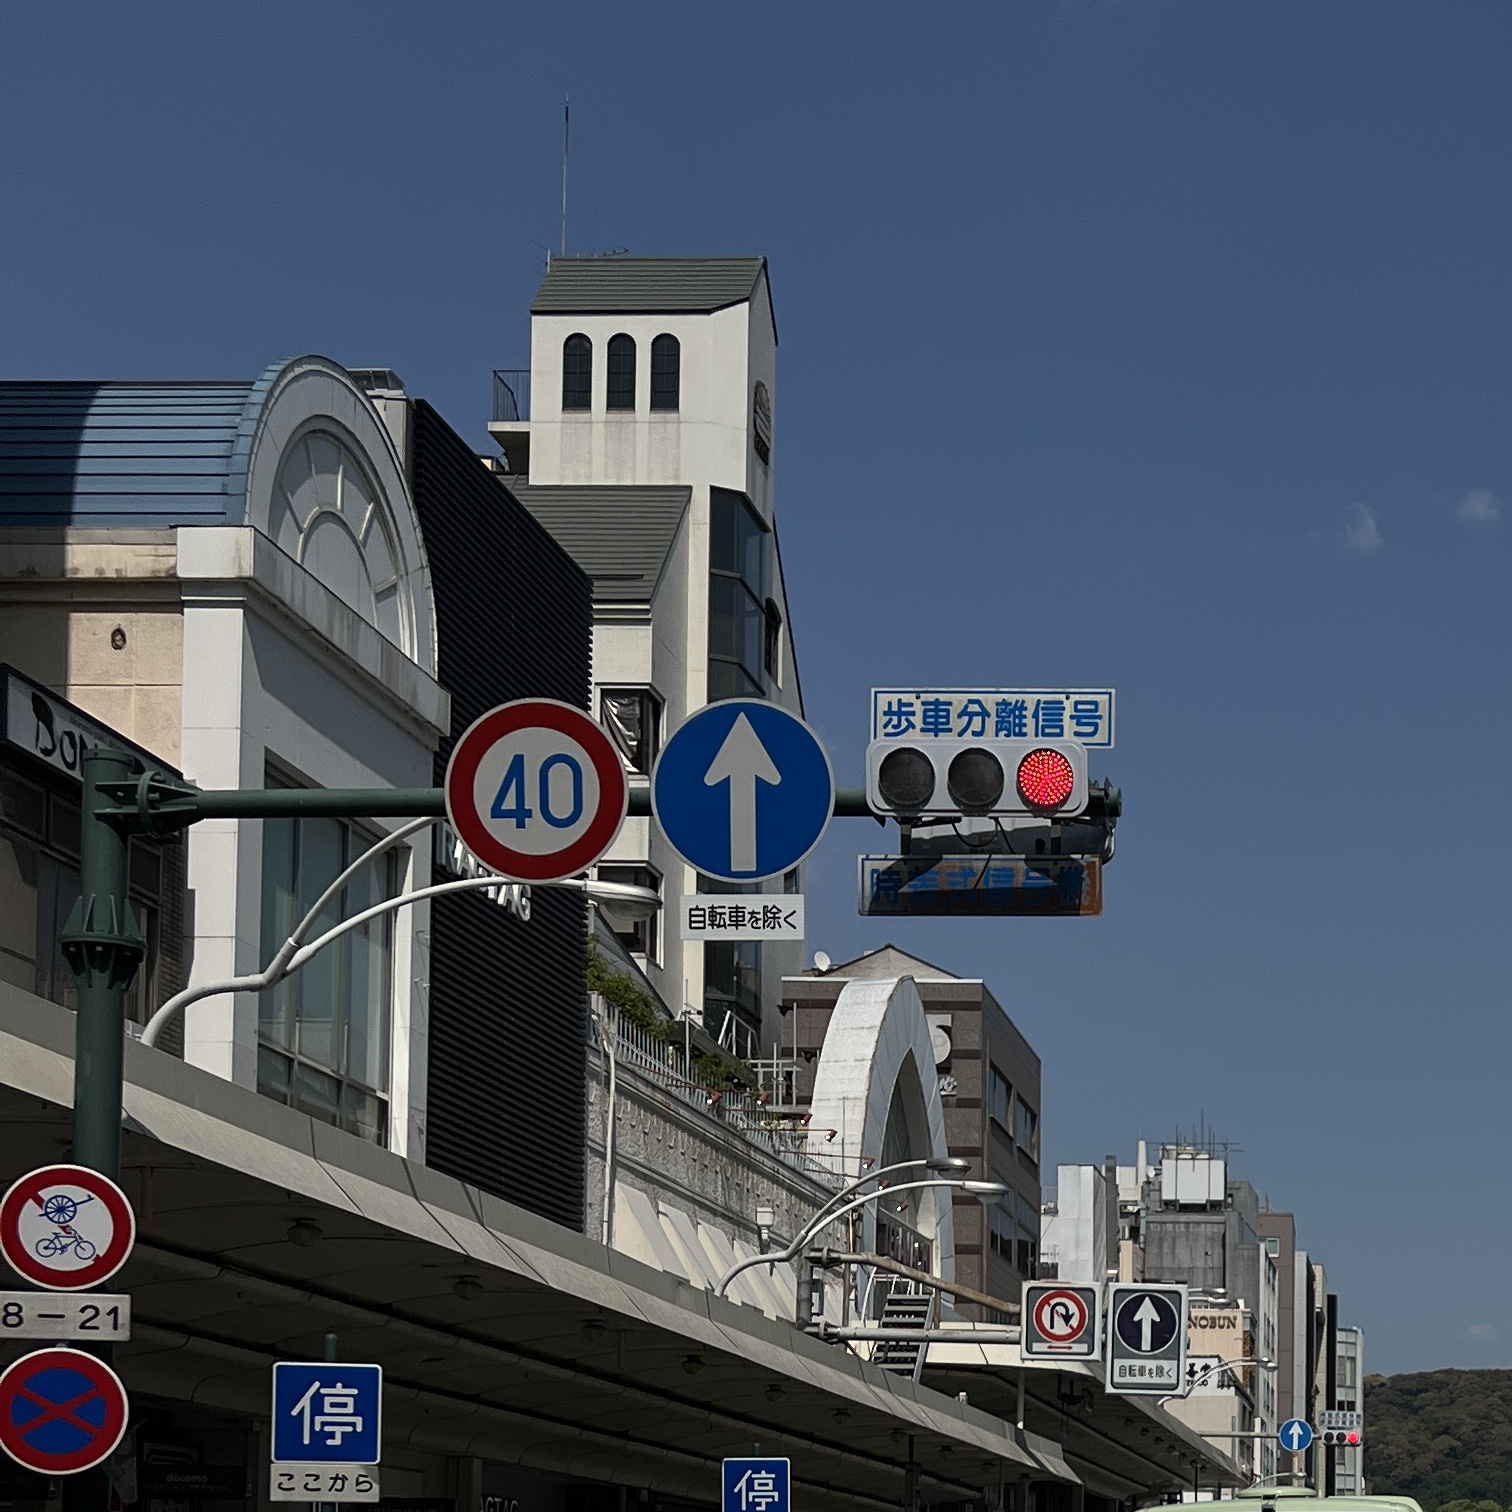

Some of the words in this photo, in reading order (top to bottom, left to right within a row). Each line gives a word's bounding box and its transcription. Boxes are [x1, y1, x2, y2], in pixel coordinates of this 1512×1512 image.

[882, 698, 1103, 738] 歩車分離信号
[490, 753, 583, 829] 40
[688, 904, 797, 931] 自転車を除く
[1118, 1364, 1173, 1379] 自転車を除く
[290, 1380, 364, 1446] 停
[277, 1473, 374, 1493] ここから
[733, 1469, 781, 1512] 停
